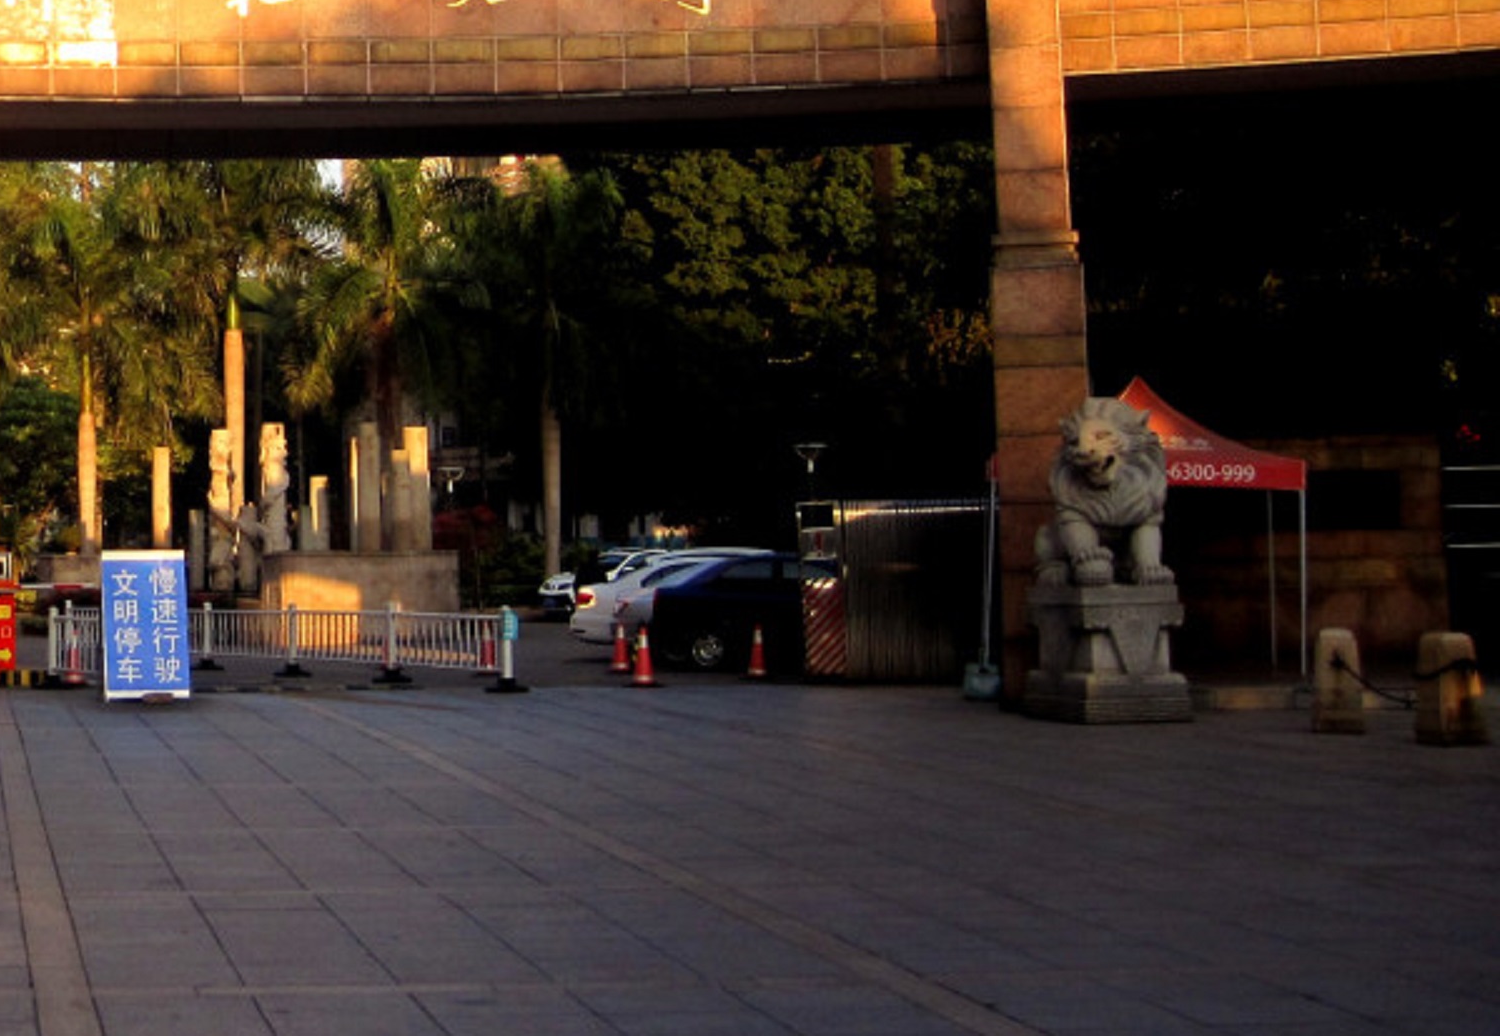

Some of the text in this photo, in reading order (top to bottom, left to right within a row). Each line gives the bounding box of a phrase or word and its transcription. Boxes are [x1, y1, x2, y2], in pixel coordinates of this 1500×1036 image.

[111, 569, 143, 683] 文明停车
[149, 568, 182, 683] 慢速行驶
